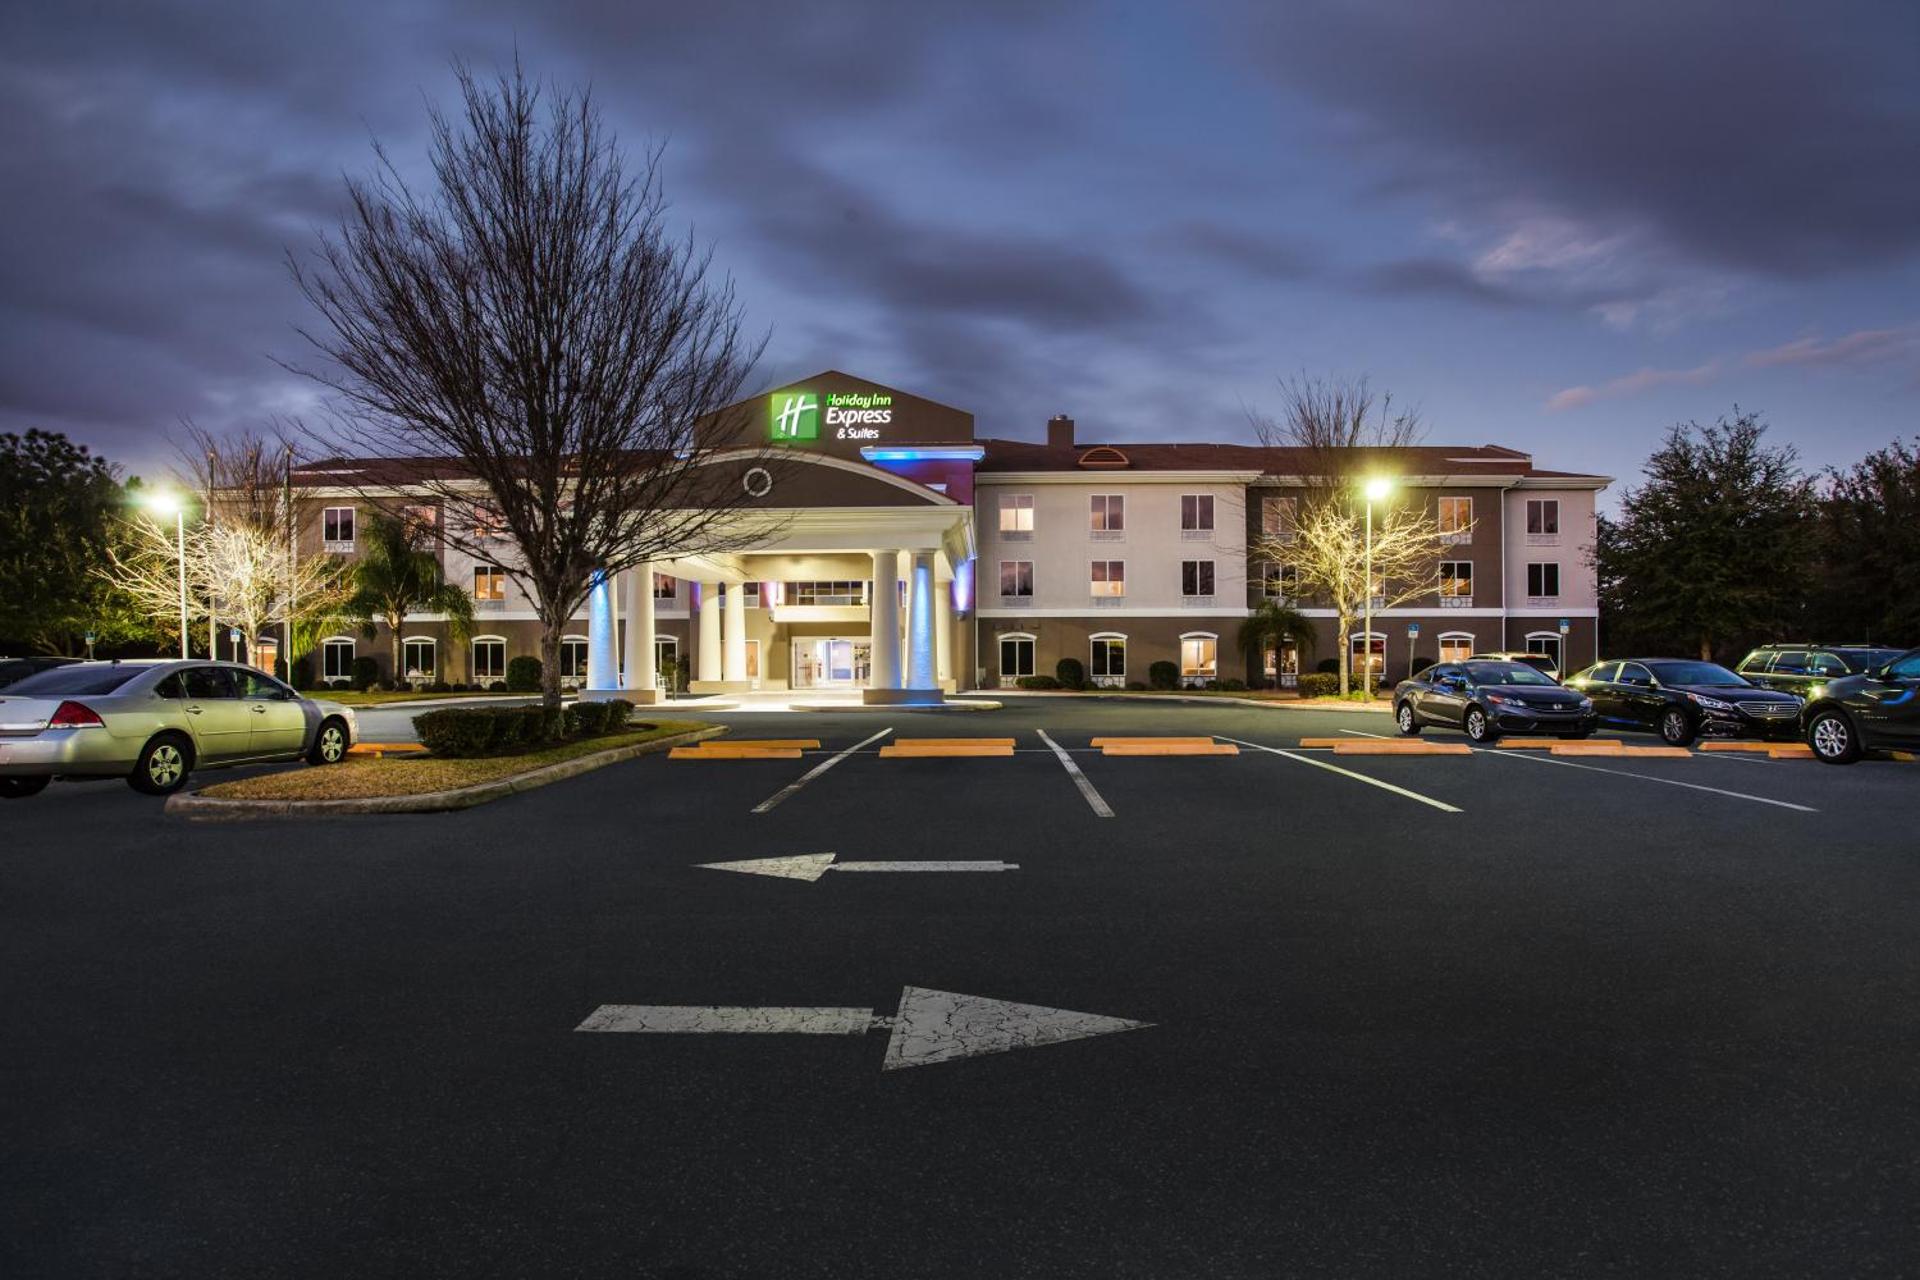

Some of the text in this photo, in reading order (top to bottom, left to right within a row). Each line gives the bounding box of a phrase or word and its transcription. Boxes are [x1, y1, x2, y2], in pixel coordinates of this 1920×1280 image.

[827, 394, 891, 408] Holiday Inn
[826, 407, 892, 427] Express
[837, 428, 879, 439] & Suites
